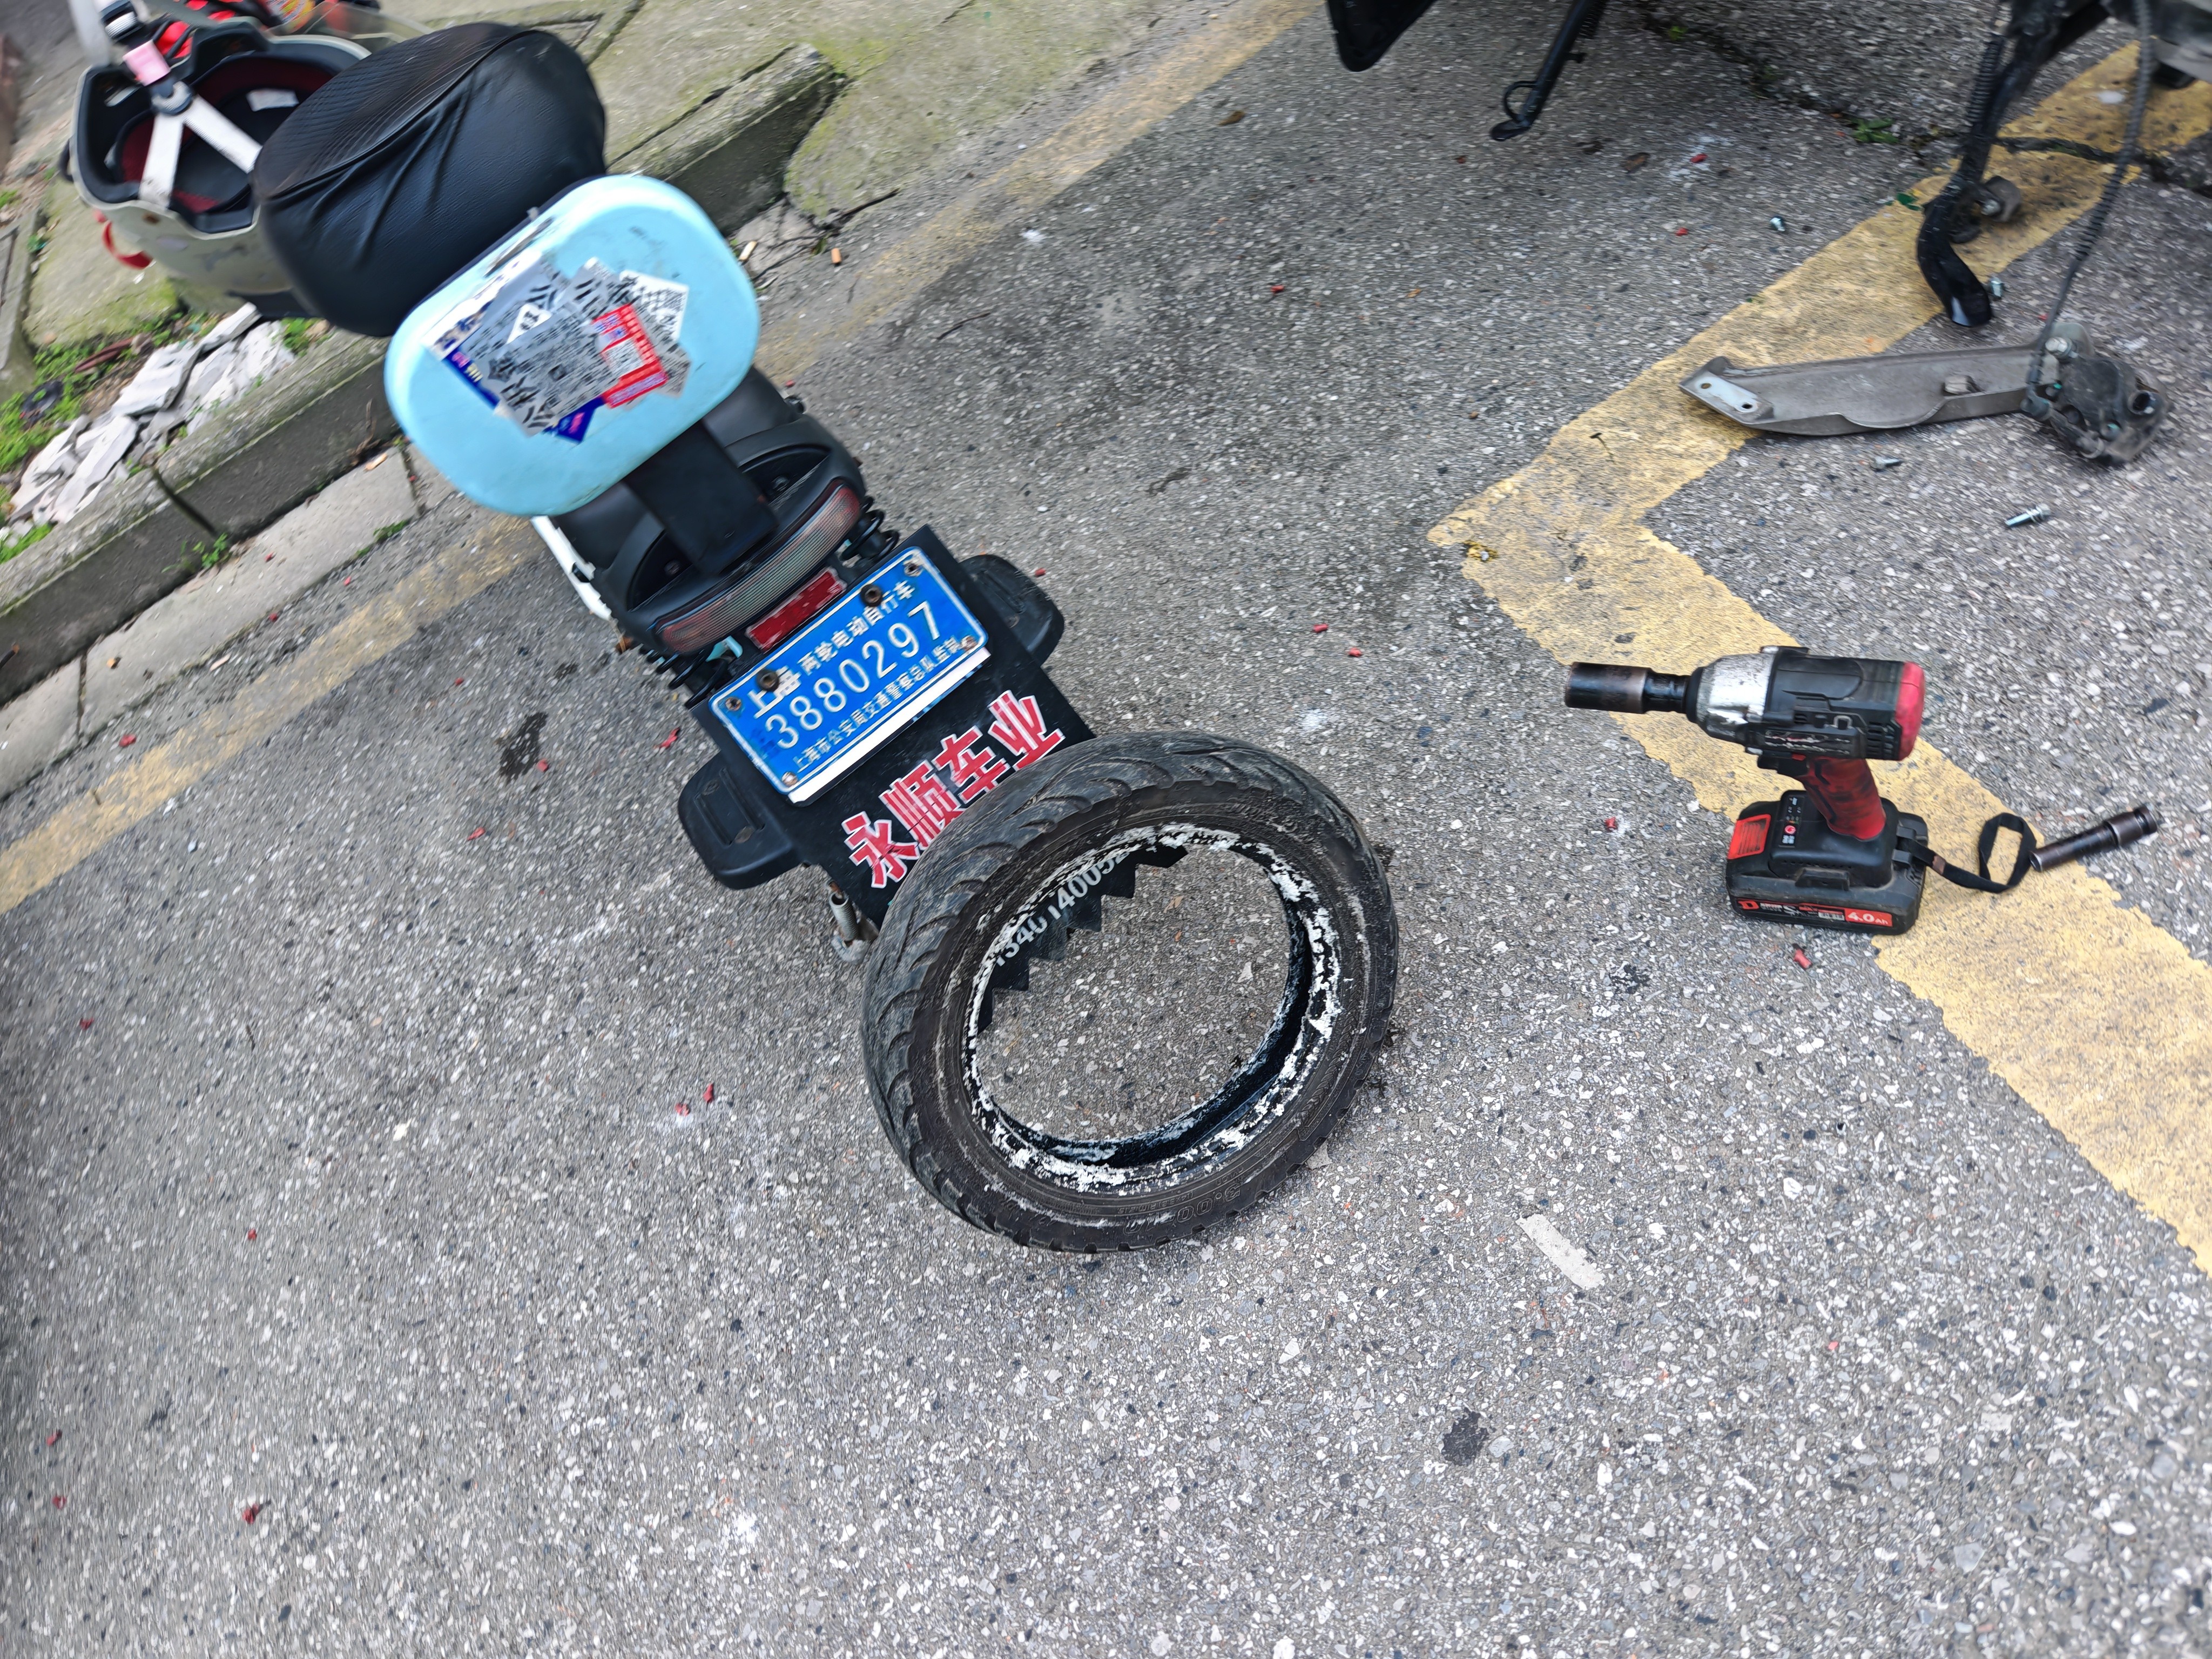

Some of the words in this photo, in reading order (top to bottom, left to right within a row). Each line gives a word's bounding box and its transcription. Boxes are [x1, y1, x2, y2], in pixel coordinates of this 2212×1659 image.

[765, 601, 940, 747] 3880297
[798, 578, 916, 675] 两轮电动自行车
[841, 689, 1065, 887] 永顺车业
